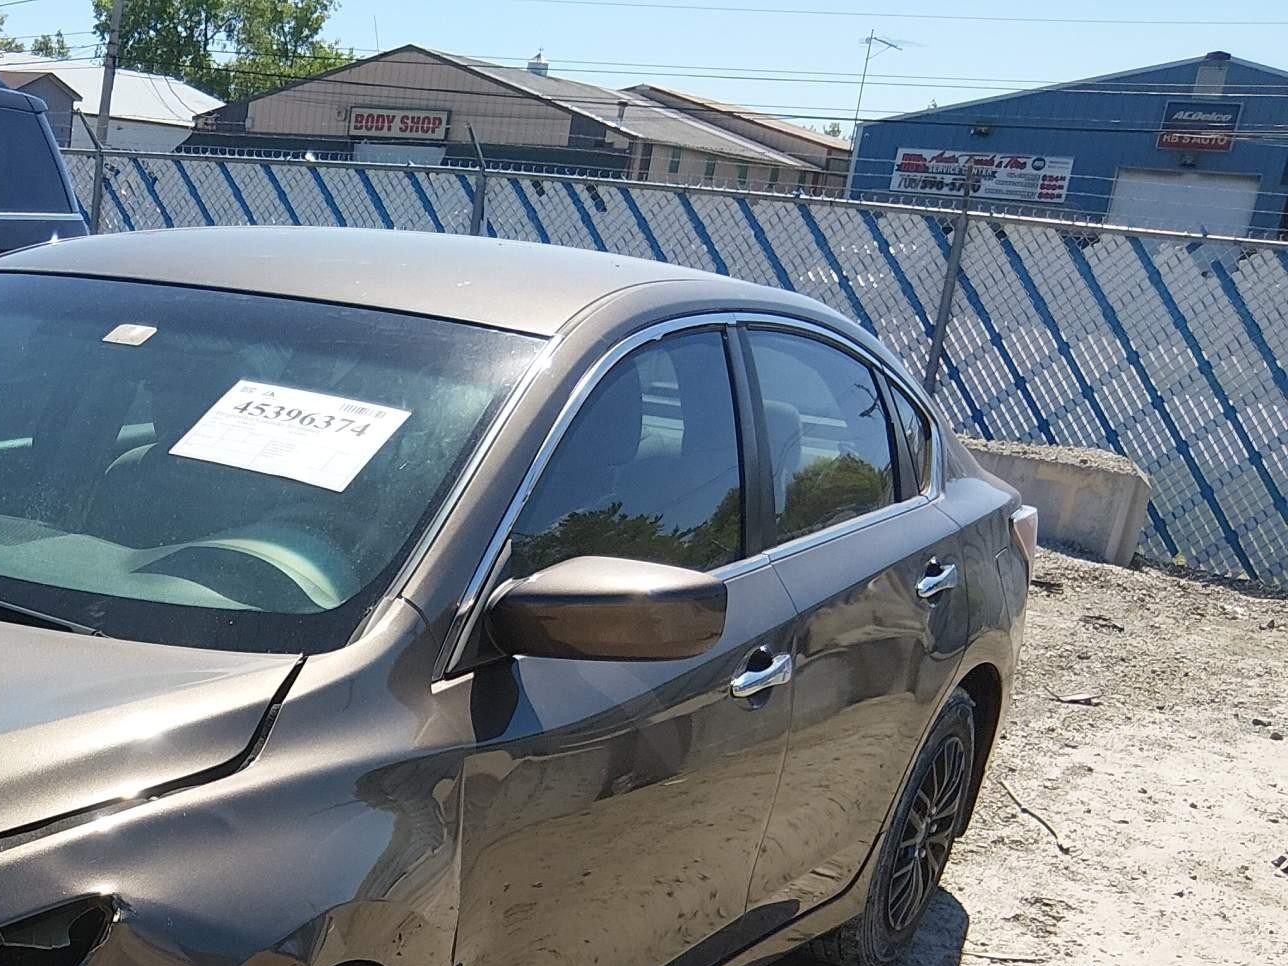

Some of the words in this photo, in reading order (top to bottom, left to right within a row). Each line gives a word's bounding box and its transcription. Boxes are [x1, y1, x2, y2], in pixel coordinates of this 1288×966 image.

[354, 113, 396, 132] BODY
[399, 115, 443, 134] SHOP
[1173, 111, 1232, 121] ACDelco
[928, 164, 960, 175] SERVICE
[961, 166, 993, 178] CNTER
[233, 400, 372, 437] 45396374
